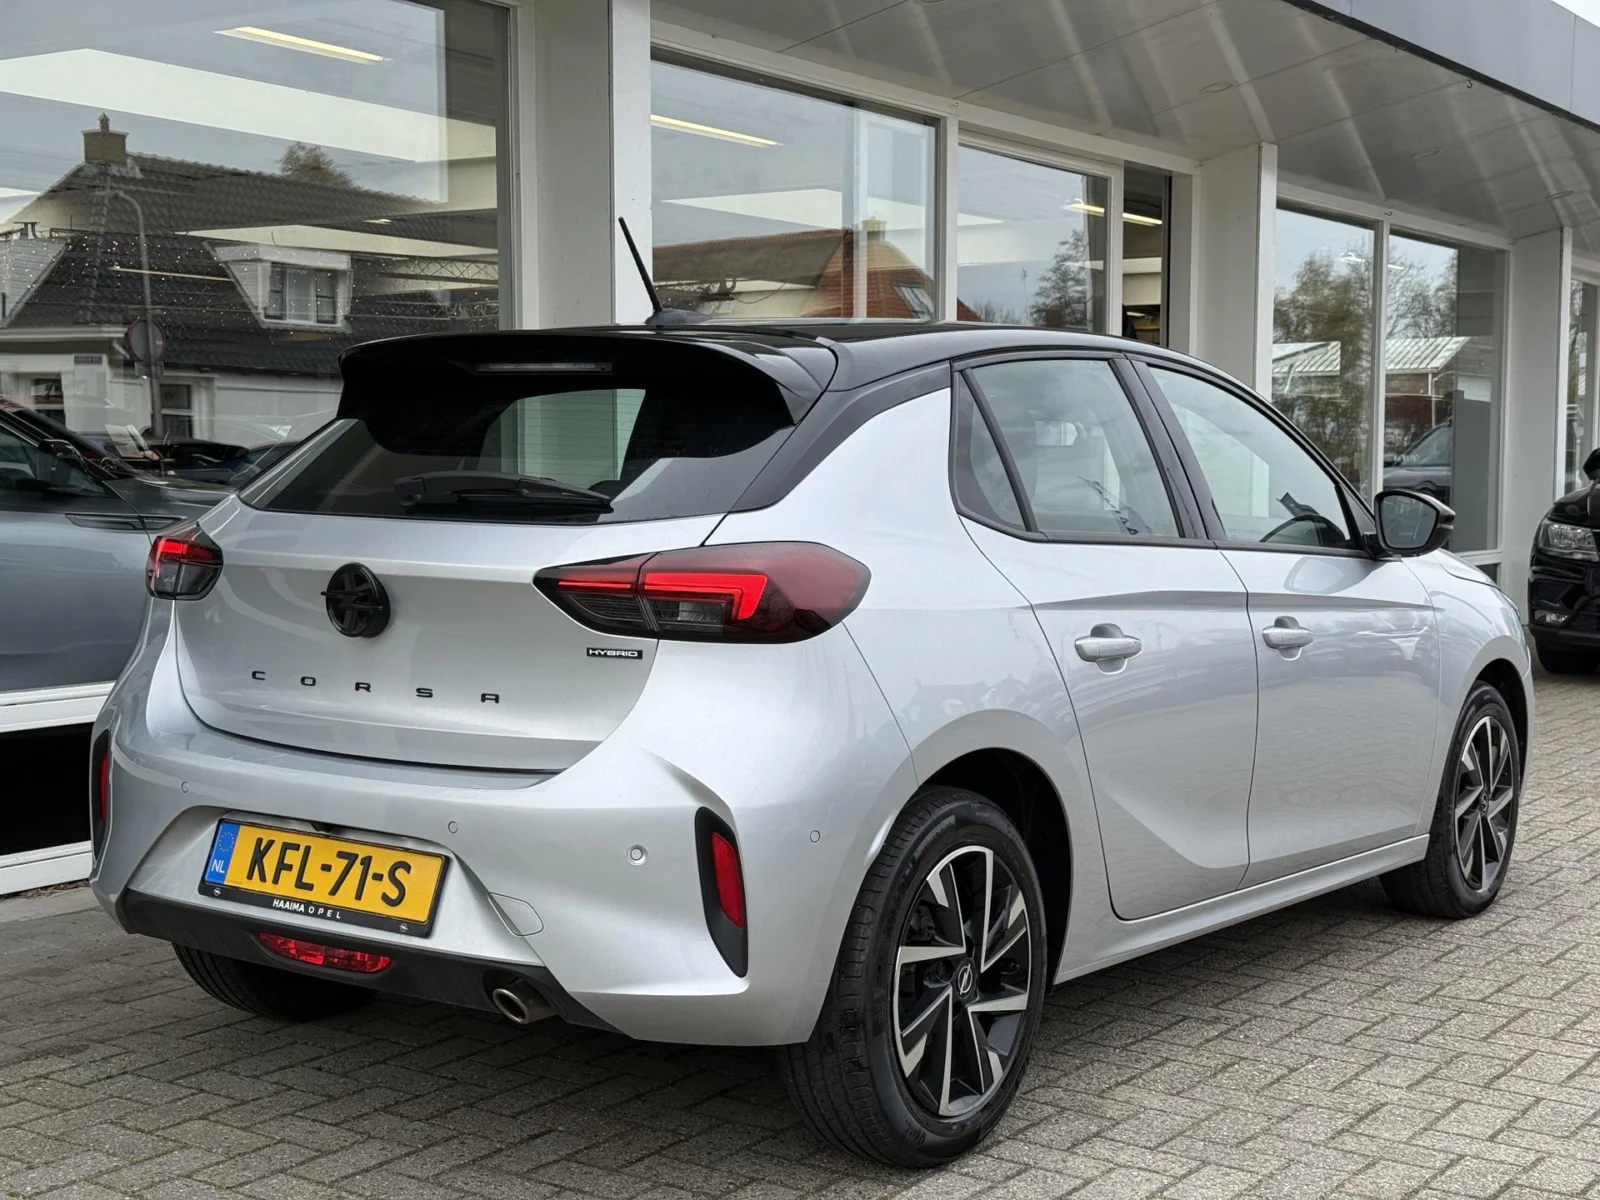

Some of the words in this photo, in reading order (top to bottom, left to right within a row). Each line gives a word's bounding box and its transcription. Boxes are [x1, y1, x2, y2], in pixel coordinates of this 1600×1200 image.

[588, 649, 639, 657] HYBRID
[251, 670, 500, 704] CORSA
[211, 858, 225, 874] NL
[246, 837, 412, 907] KFL-71-S
[272, 898, 305, 913] HAAIMA
[308, 905, 341, 919] OPEL
